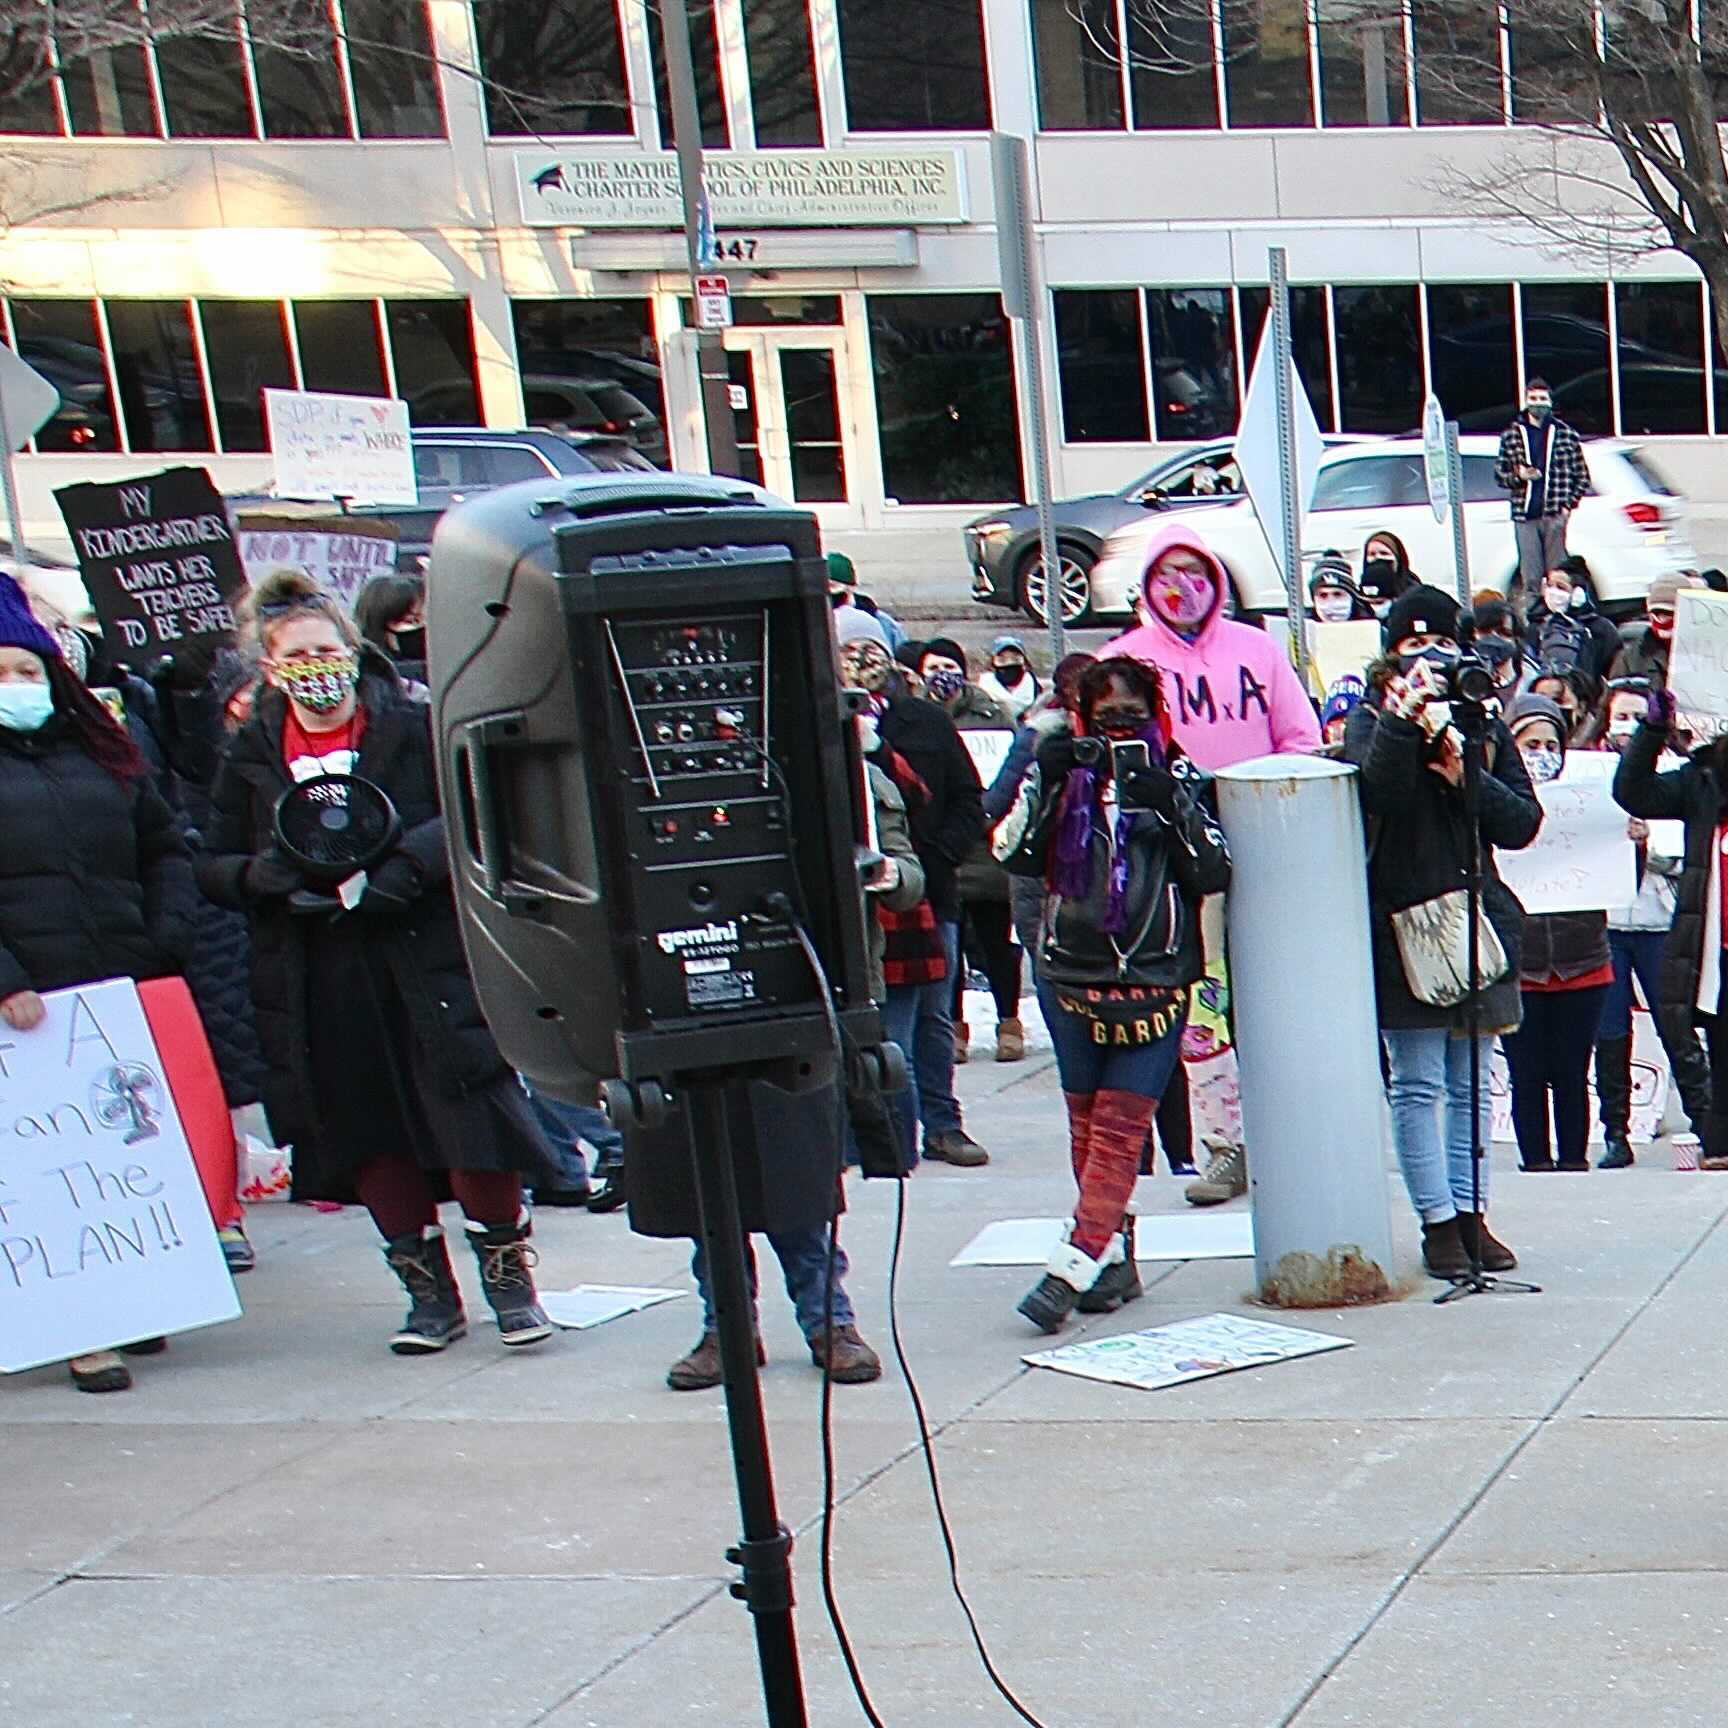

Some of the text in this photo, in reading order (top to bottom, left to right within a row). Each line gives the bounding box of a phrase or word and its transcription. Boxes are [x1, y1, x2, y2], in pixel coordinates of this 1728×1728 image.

[571, 159, 945, 181] THE MATHETICS, CIVICS AND SCIENCES
[574, 180, 661, 199] CHARTER
[739, 179, 761, 197] OF
[912, 178, 948, 196] INC.
[118, 484, 151, 519] MY
[113, 554, 217, 592] WANTS HER
[129, 582, 222, 616] TEACHERS
[115, 617, 148, 649] TO
[153, 613, 183, 642] BE
[655, 919, 739, 955] gemini
[64, 991, 121, 1067] A
[41, 1159, 165, 1209] The
